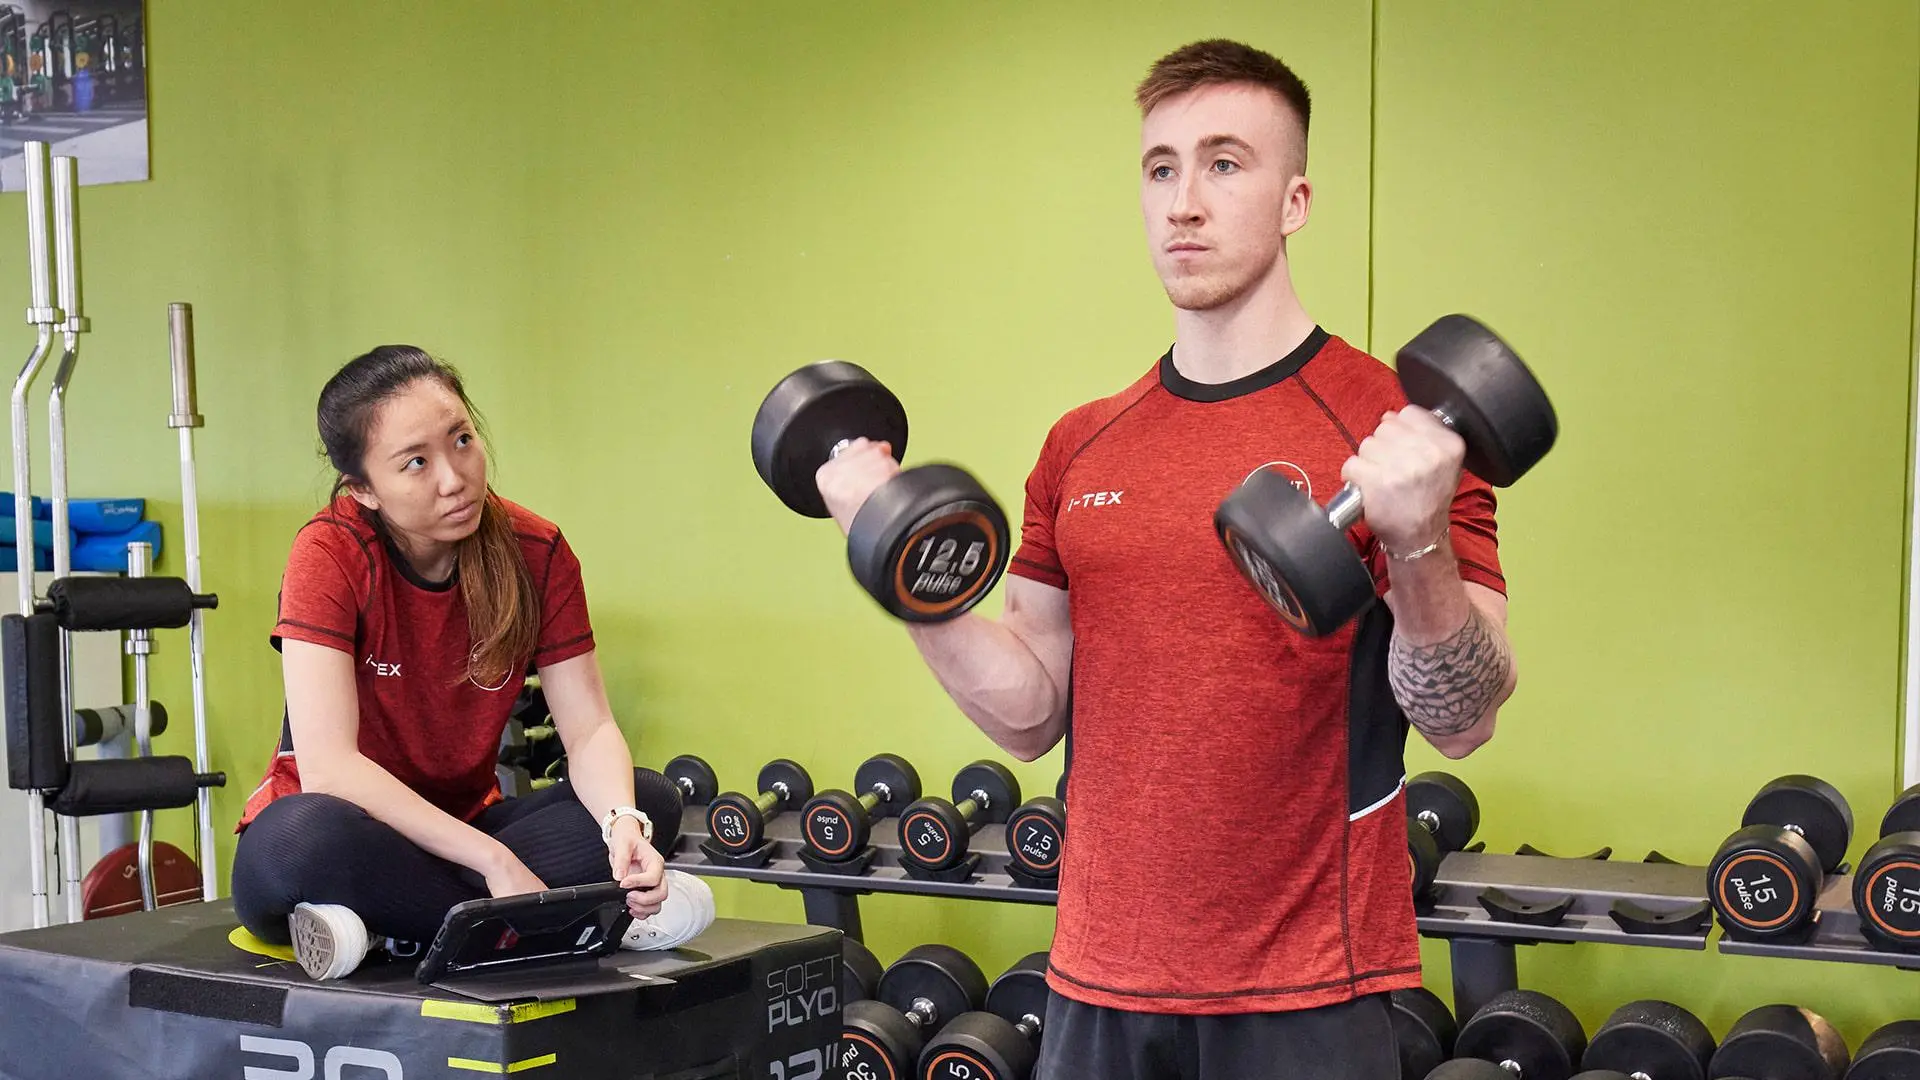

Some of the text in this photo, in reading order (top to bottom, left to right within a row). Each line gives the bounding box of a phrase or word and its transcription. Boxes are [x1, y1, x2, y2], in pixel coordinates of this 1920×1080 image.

[911, 571, 963, 595] pulse
[720, 815, 737, 838] 2.5
[732, 815, 745, 836] pulse
[816, 815, 839, 825] pulse
[823, 825, 834, 840] 5
[917, 833, 932, 847] 5
[923, 821, 945, 843] pulse
[1026, 826, 1054, 851] 7.5
[1021, 844, 1049, 861] pulse
[1730, 877, 1754, 911] pulse
[1750, 874, 1778, 903] 15
[1883, 876, 1898, 912] pulse
[1899, 887, 1920, 915] 15
[766, 953, 841, 1002] SOFT
